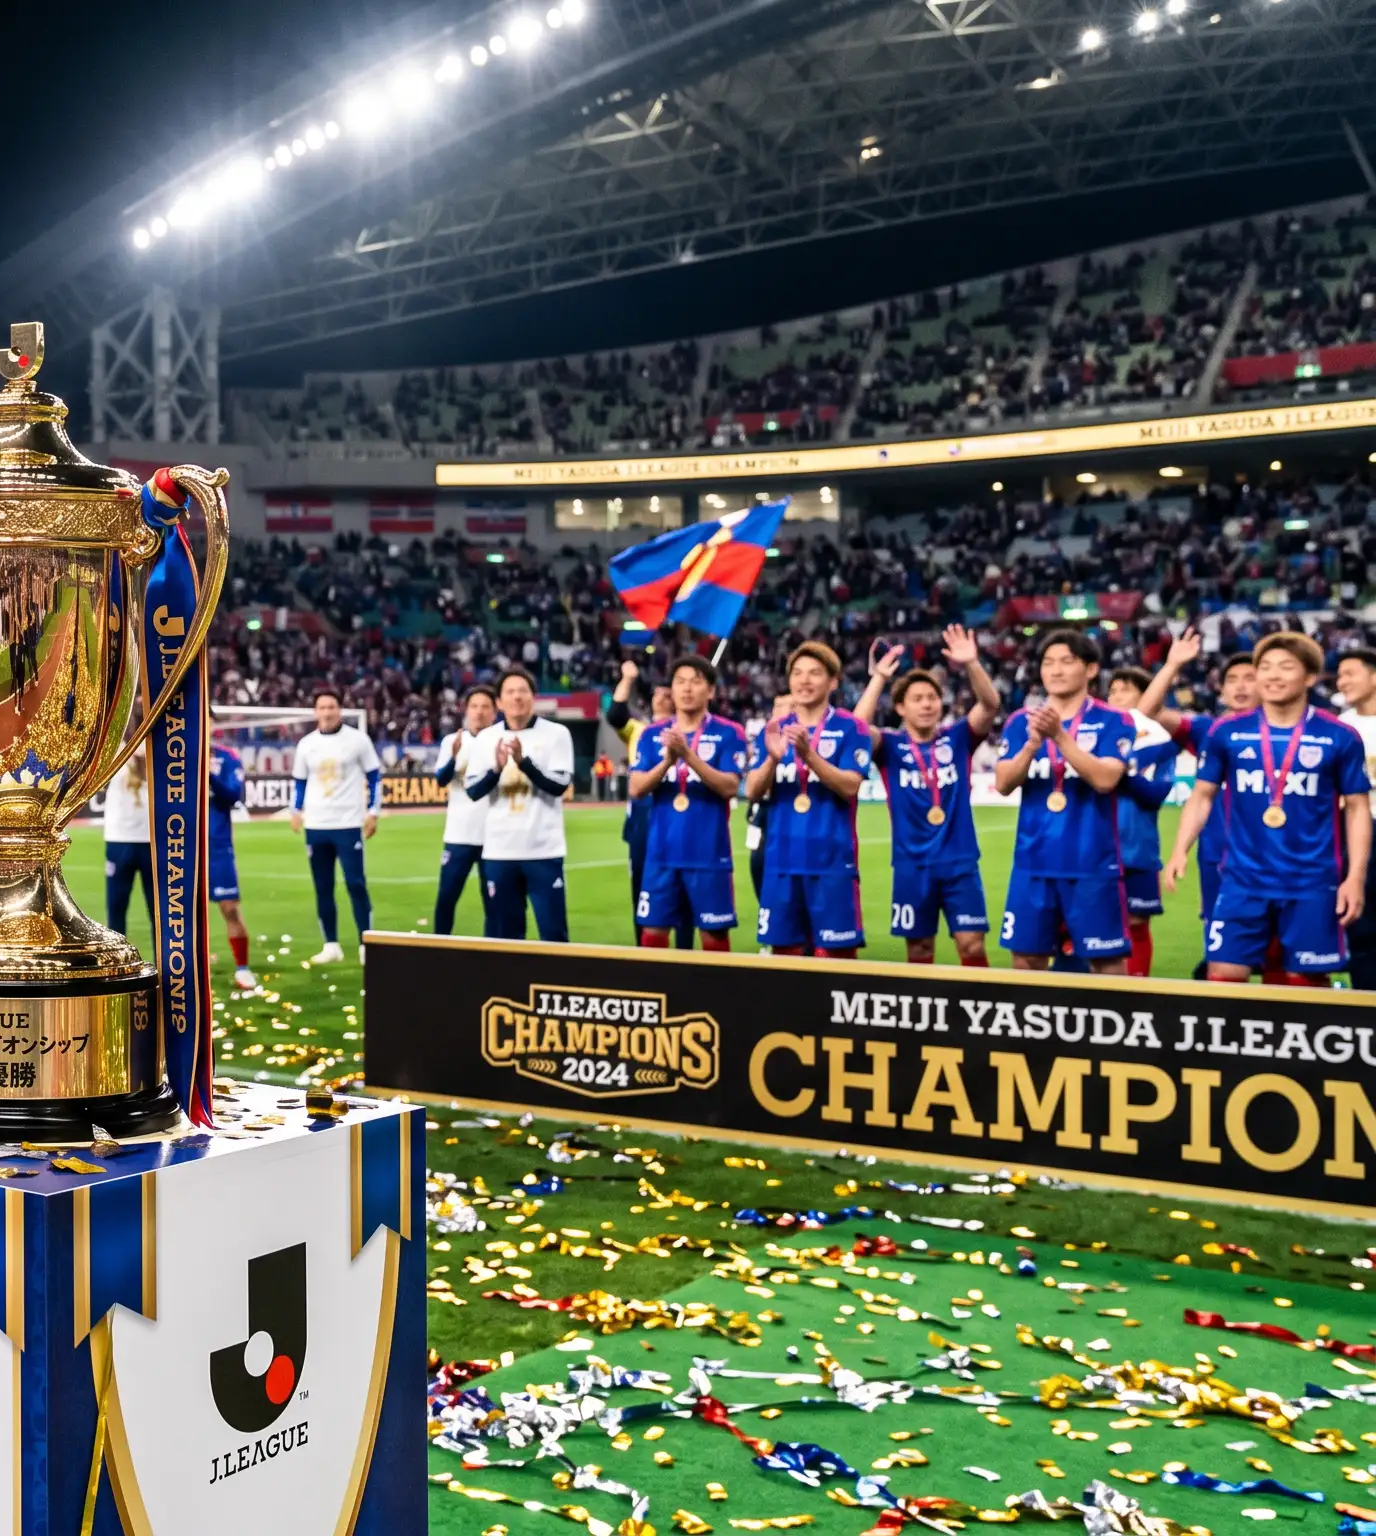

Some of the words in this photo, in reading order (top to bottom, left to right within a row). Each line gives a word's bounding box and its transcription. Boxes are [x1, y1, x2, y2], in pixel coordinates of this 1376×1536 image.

[1236, 769, 1319, 797] MXI
[1208, 920, 1225, 952] 5
[536, 993, 659, 1024] J.LEAGUE
[830, 990, 949, 1032] MEIJI
[959, 999, 1162, 1049] YASUDA
[487, 1005, 712, 1080] CHAMPIONS
[562, 1057, 629, 1087] 2024
[749, 1032, 1376, 1180] CHAMPION
[210, 1421, 308, 1485] J.LEAGUE
